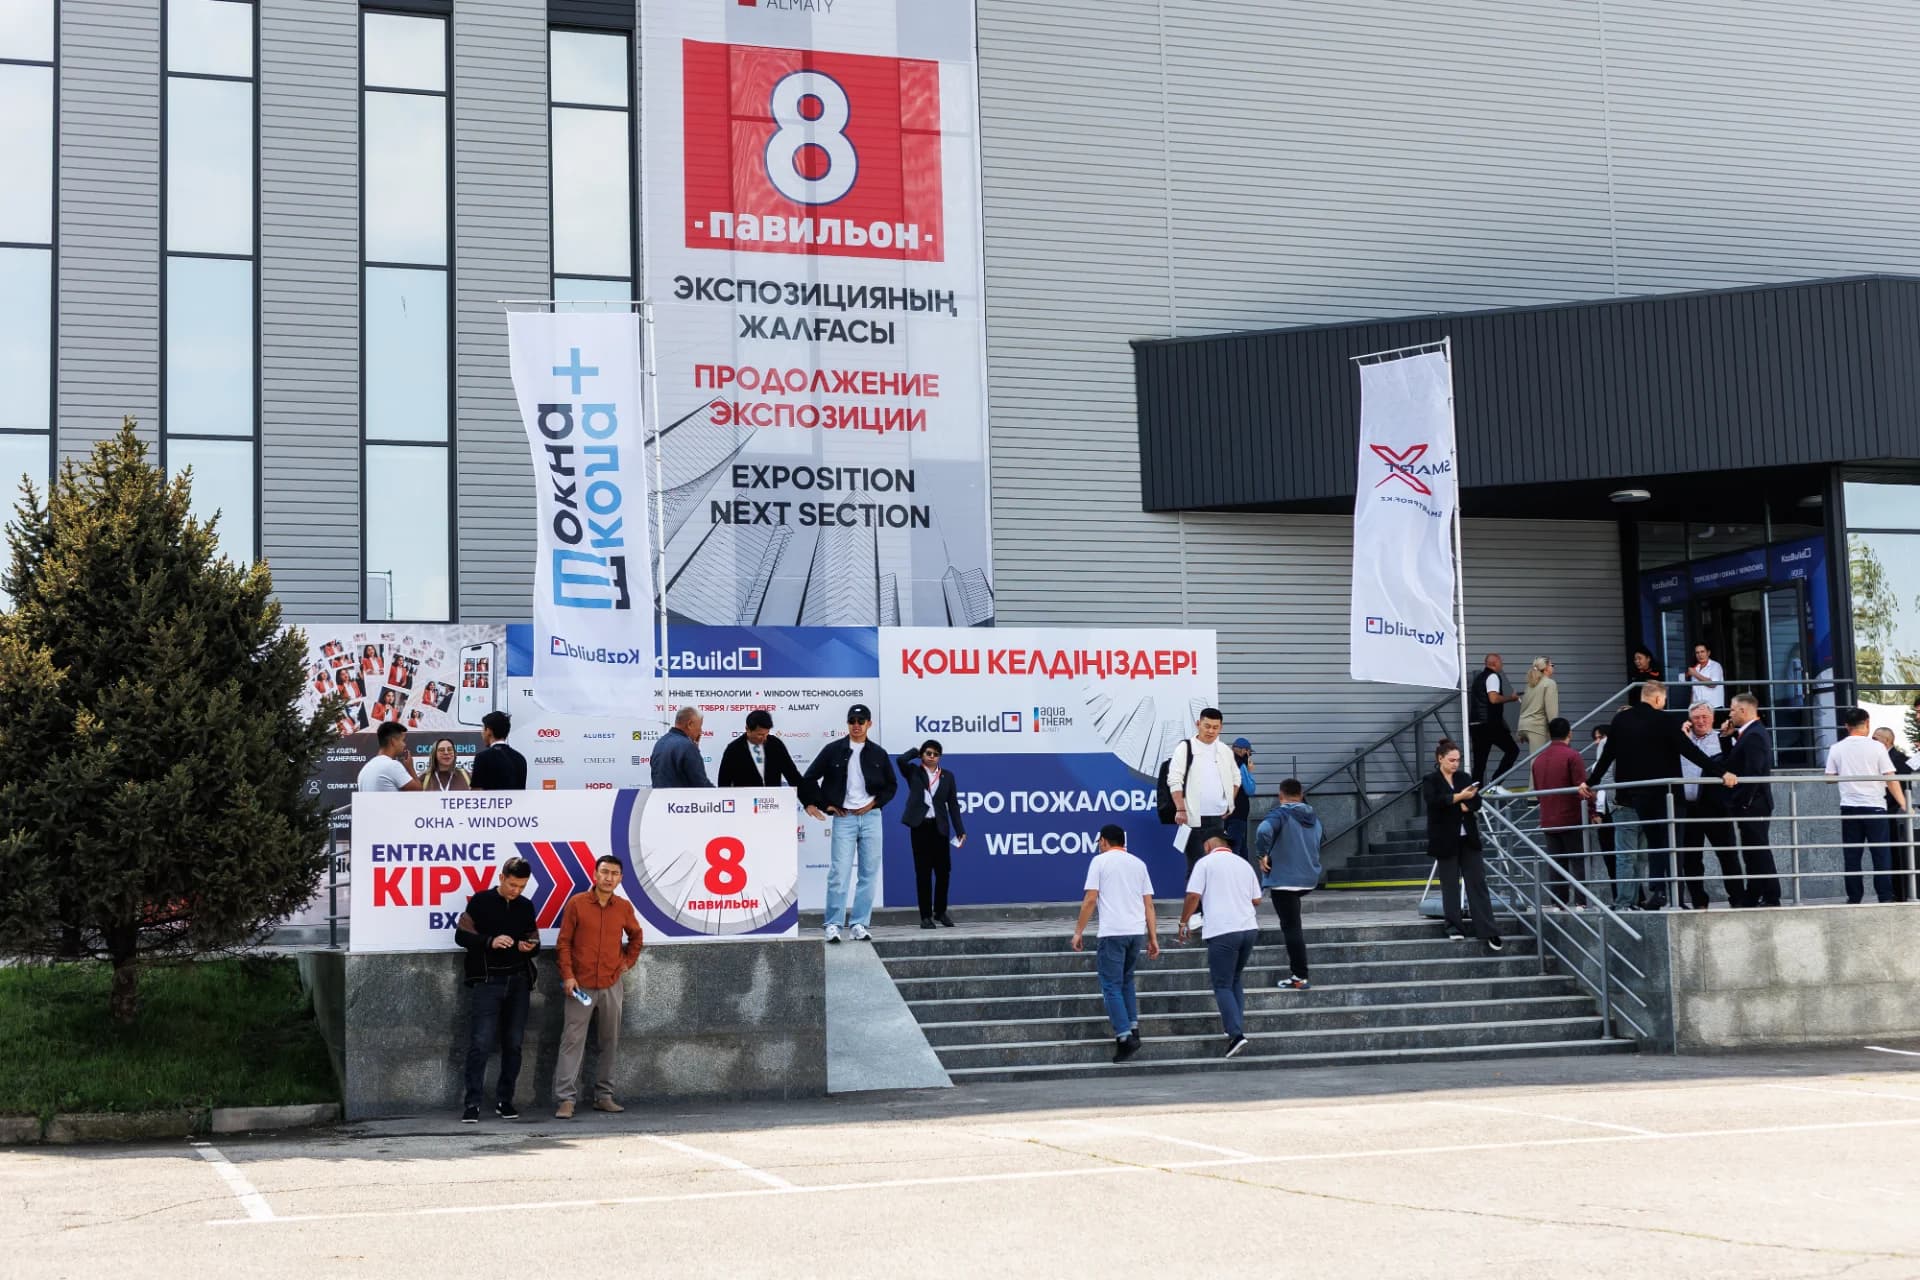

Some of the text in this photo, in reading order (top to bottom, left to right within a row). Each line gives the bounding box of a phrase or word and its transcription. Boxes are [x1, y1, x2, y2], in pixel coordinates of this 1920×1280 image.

[767, 0, 834, 13] ALMATY
[764, 69, 859, 206] 8
[673, 275, 957, 317] ЭКСПОЗИЦИЯНЫҢ
[739, 314, 895, 344] ЖАЛҒАСЫ
[694, 364, 939, 397] ПРОДОЛЖЕНИЕ
[709, 401, 927, 434] ЭКСПОЗИЦИИ
[732, 465, 915, 493] EXPOSITION
[710, 500, 930, 528] NEXT SECTION
[655, 650, 736, 670] azBuild
[902, 649, 1197, 680] ҚОШ КЕЛДІҢІЗДЕР!
[802, 690, 864, 698] TECHNOLOGIES
[1040, 706, 1065, 717] aqua
[1040, 716, 1073, 727] THERM
[915, 714, 1000, 733] KazBuild
[585, 782, 613, 790] HOPO
[441, 797, 513, 809] ТЕРЕЗЕЛЕР
[668, 802, 720, 813] KazBuild
[956, 790, 1005, 814] БРО
[1010, 789, 1158, 813] ПОЖАЛОВА
[414, 816, 454, 829] ОКНА
[468, 815, 539, 828] WINDOWS
[371, 842, 495, 862] ENTRANCE
[703, 836, 748, 895] 8
[373, 865, 497, 907] КІРУ
[688, 899, 758, 910] павильон
[429, 911, 458, 929] ВХ
